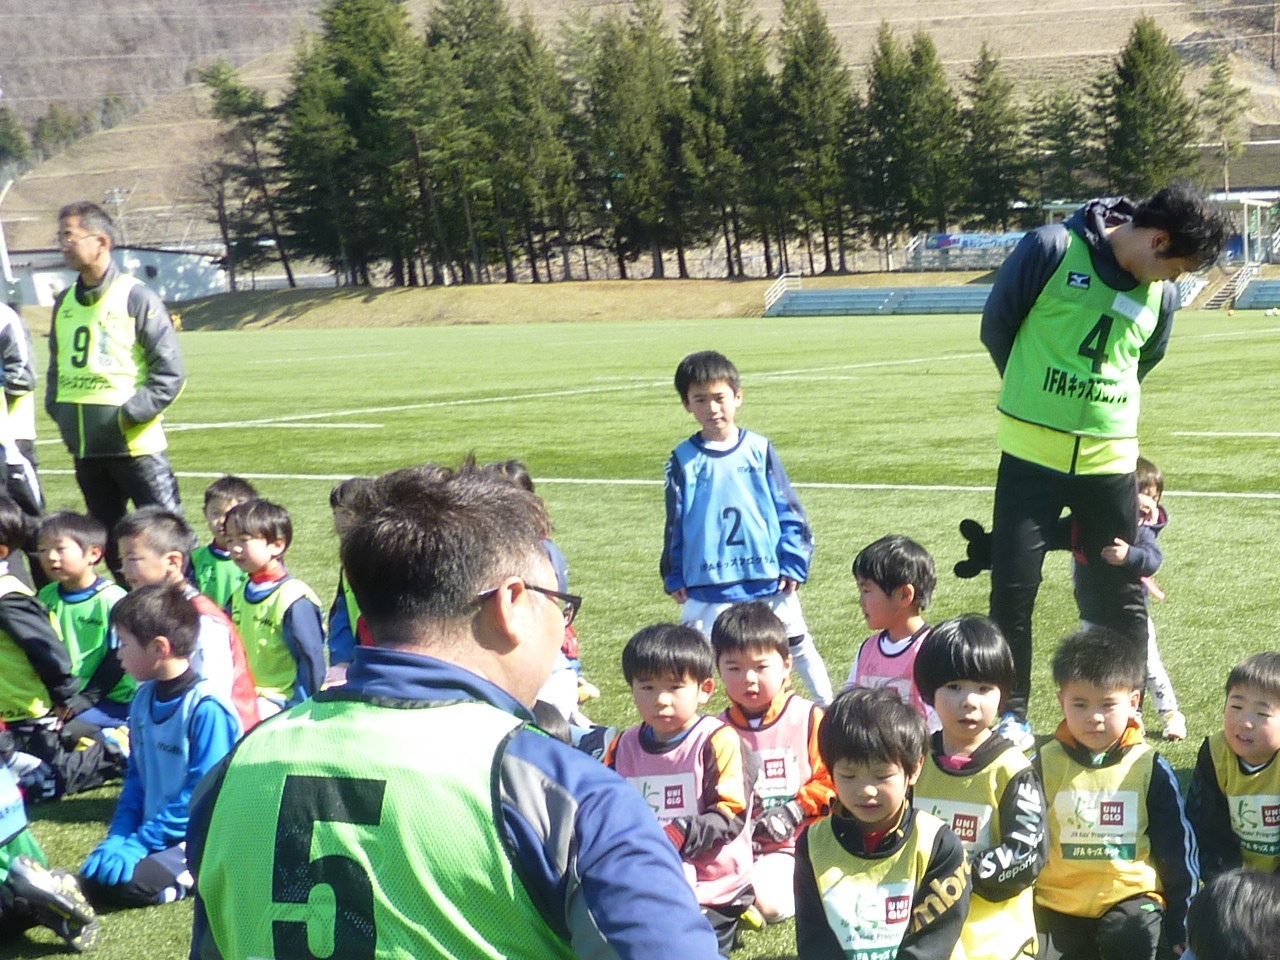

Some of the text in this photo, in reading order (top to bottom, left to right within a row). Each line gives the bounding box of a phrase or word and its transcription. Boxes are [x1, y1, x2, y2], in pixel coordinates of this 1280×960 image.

[71, 325, 91, 368] 9
[1078, 313, 1114, 375] 4
[722, 506, 745, 547] 2
[666, 789, 681, 797] UNI
[666, 796, 681, 805] QLO
[1102, 813, 1121, 821] QLO
[956, 819, 974, 828] UNI
[954, 827, 974, 837] QLO
[888, 900, 909, 910] UNI
